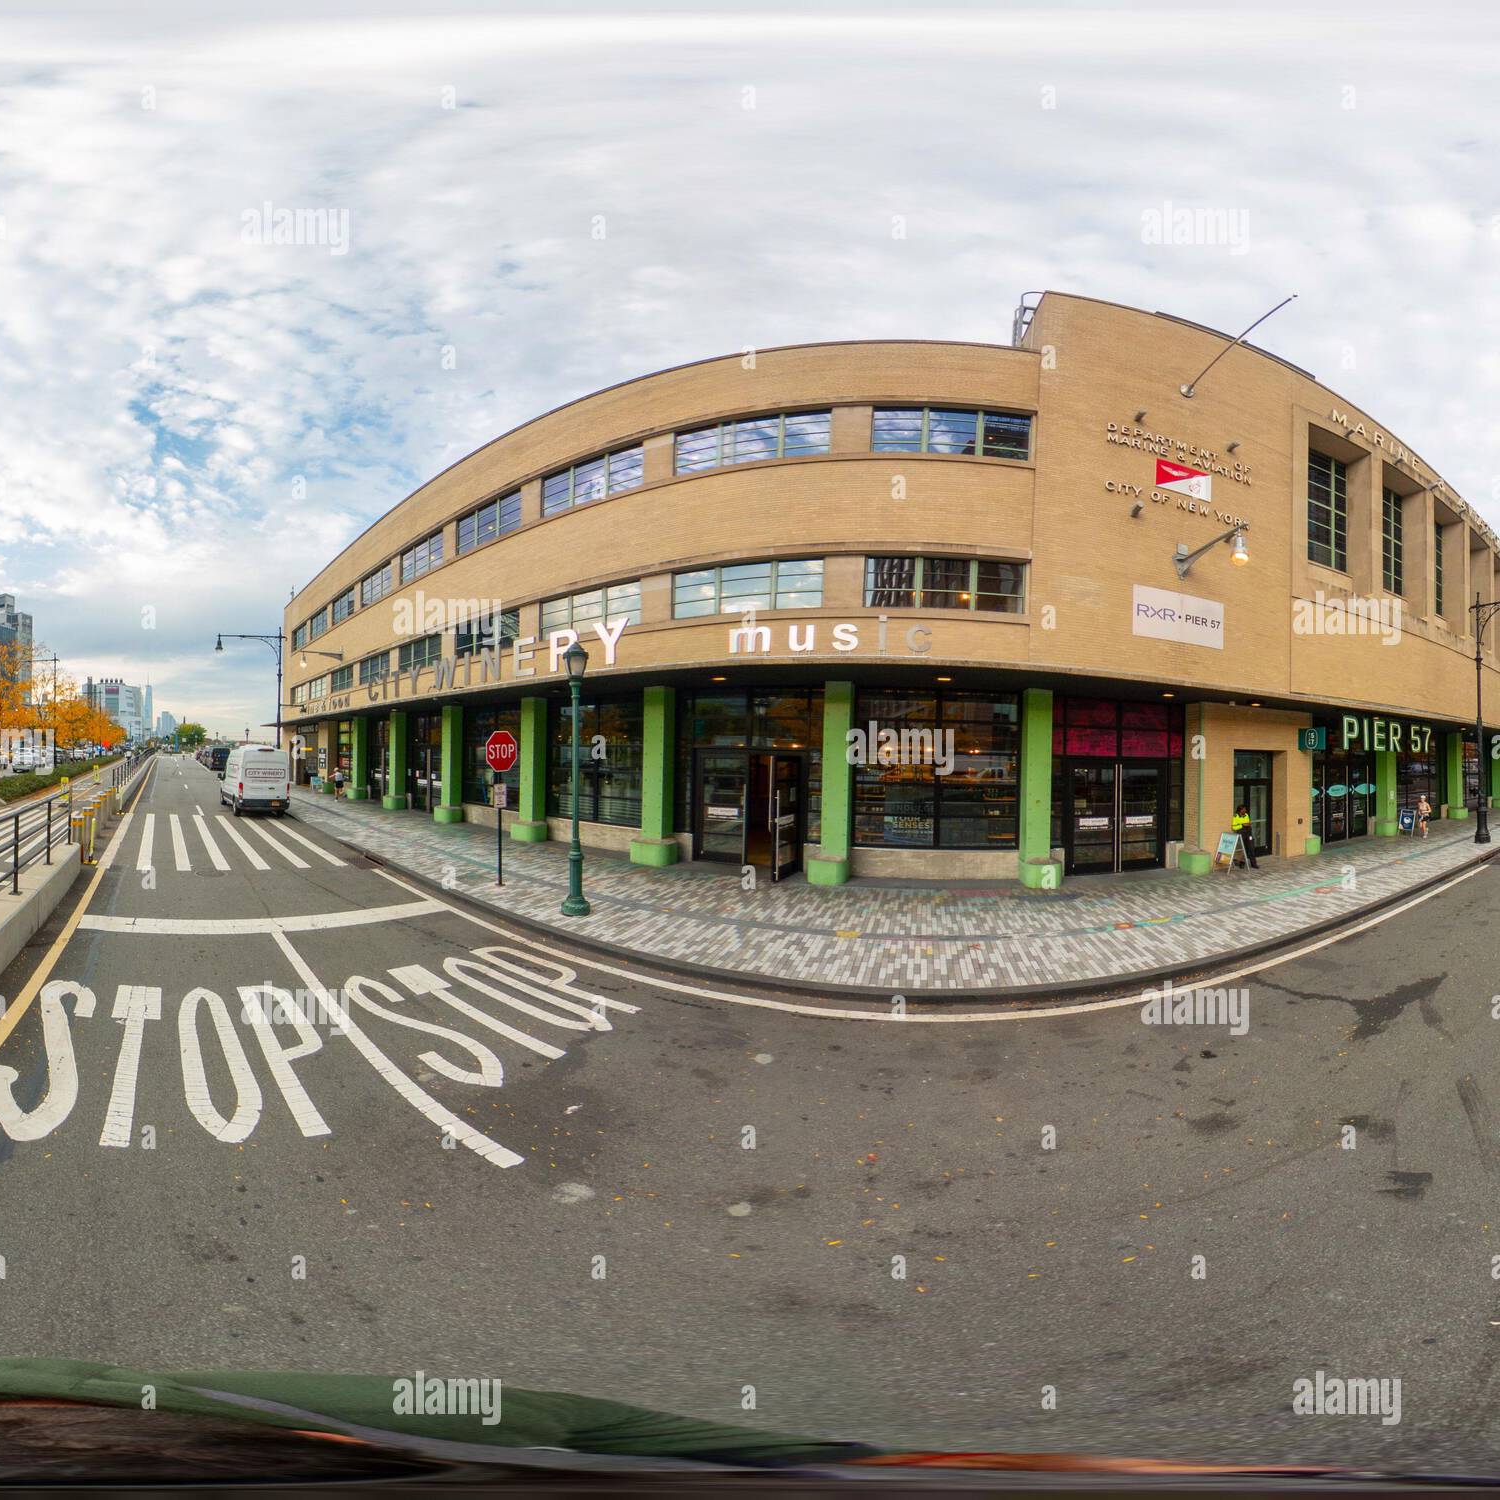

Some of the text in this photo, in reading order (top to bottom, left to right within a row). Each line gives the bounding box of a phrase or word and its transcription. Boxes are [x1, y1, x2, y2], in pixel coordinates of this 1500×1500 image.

[1107, 422, 1253, 473] DEPARTMENT OF
[1107, 432, 1252, 486] MARINE & AVIATION
[1332, 408, 1421, 472] MARINE
[1105, 480, 1142, 496] CITY
[1151, 490, 1170, 504] OF
[1176, 498, 1210, 517] NEW
[729, 615, 933, 654] music
[1137, 603, 1221, 630] RXR PIER 57
[368, 617, 630, 702] CITY WINERY
[488, 743, 515, 760] STOP
[1342, 714, 1432, 754] PIER 57
[345, 946, 642, 1088] STOP
